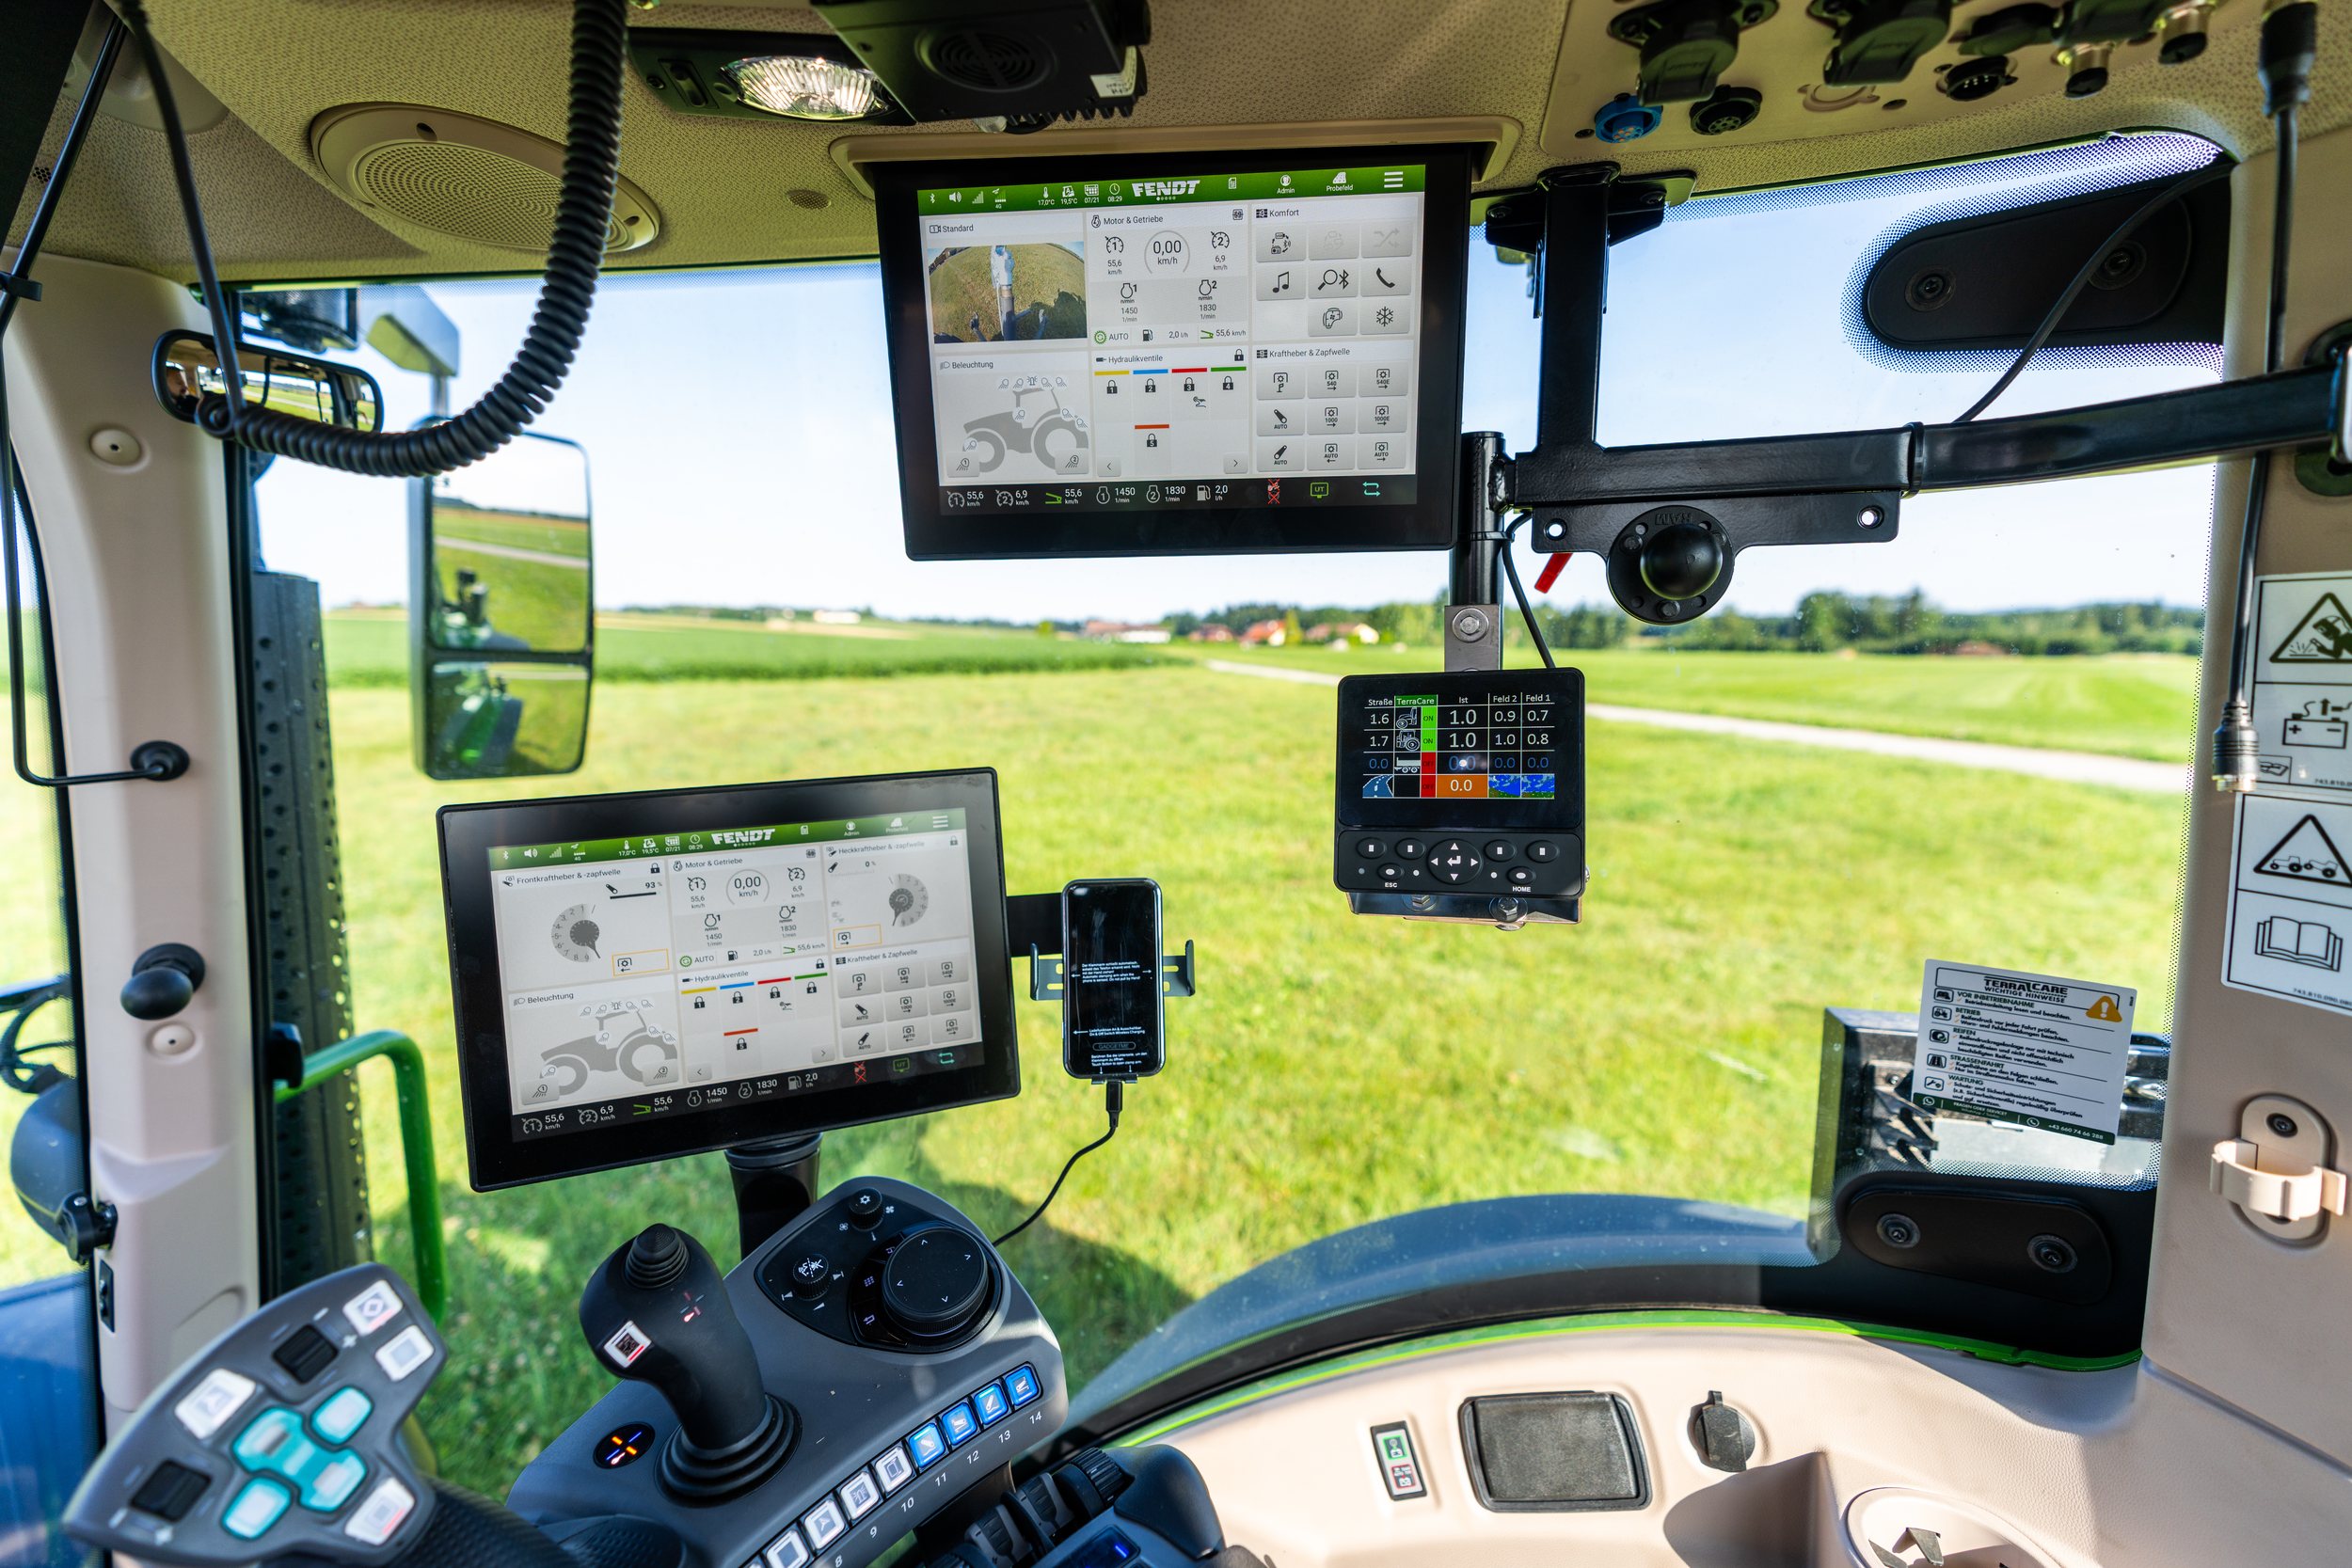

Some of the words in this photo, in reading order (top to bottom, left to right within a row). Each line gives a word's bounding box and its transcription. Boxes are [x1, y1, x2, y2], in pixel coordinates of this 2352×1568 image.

[1132, 180, 1200, 198] FENDT
[1269, 209, 1299, 217] Komfort
[1133, 215, 1164, 224] Getriebe
[942, 224, 974, 233] Standard
[1152, 240, 1182, 256] 0,00
[1107, 260, 1122, 268] 55,6
[1157, 257, 1178, 265] km/h
[1215, 255, 1226, 263] 6,9
[1269, 349, 1307, 357] Kraftheber
[1315, 348, 1350, 357] Zapfwelle
[1108, 354, 1163, 365] Hydraulikventile
[952, 360, 993, 371] Beleuchtung
[1015, 489, 1028, 500] 6,9
[1065, 488, 1083, 499] 55,6
[1114, 487, 1136, 497] 1450
[1165, 485, 1185, 496] 1830
[1215, 484, 1229, 496] 2,0
[966, 491, 984, 501] 55,6
[1370, 714, 1390, 724] 1.6
[1450, 709, 1477, 724] 1.0
[1494, 711, 1516, 722] 0.9
[1527, 710, 1549, 721] 0.7
[1370, 736, 1389, 747] 1.7
[1449, 733, 1476, 748] 1.0
[1495, 734, 1516, 745] 1.0
[1527, 734, 1549, 745] 0.8
[1369, 758, 1389, 768] 0.0
[1449, 755, 1476, 770] 0.0
[1494, 757, 1516, 768] 0.0
[1527, 757, 1549, 768] 0.0
[1450, 780, 1472, 791] 0.0
[711, 829, 775, 846] FENDT
[839, 845, 887, 855] Heckkraftheber
[685, 860, 706, 868] Motor
[713, 857, 742, 866] Getriebe
[516, 873, 575, 884] Frontkraftheber
[583, 868, 621, 879] -zapfwelle
[734, 876, 761, 890] 0,00
[706, 932, 723, 941] 1450
[798, 942, 811, 951] 55,6
[694, 955, 714, 963] AUTO
[848, 954, 881, 963] Kraftheber
[888, 949, 917, 958] Zapfwelle
[694, 970, 749, 983] Hydraulikventile
[528, 992, 574, 1005] Beleuchtung
[1957, 990, 1972, 999] VOR
[1974, 993, 2035, 1007] INBETRIEBNAHME
[1985, 987, 2022, 997] WICHTIGE
[2026, 992, 2065, 1003] HINWEISE
[1956, 1007, 1980, 1016] BETRIEB
[1953, 1027, 1976, 1036] REIFEN
[1950, 1054, 2005, 1069] STRASSENFAHRT
[805, 1072, 818, 1083] 2,0
[1948, 1075, 1984, 1085] WARTUNG
[756, 1079, 778, 1089] 1830
[707, 1087, 727, 1098] 1450
[654, 1096, 673, 1106] 55,6
[600, 1105, 614, 1116] 6,9
[545, 1113, 564, 1124] 55,6
[1029, 1411, 1042, 1424] 14
[999, 1430, 1011, 1444] 13
[967, 1450, 979, 1465] 12
[935, 1472, 947, 1487] 11
[901, 1497, 914, 1513] 10
[869, 1526, 878, 1539] 9
[835, 1555, 843, 1568] 8
